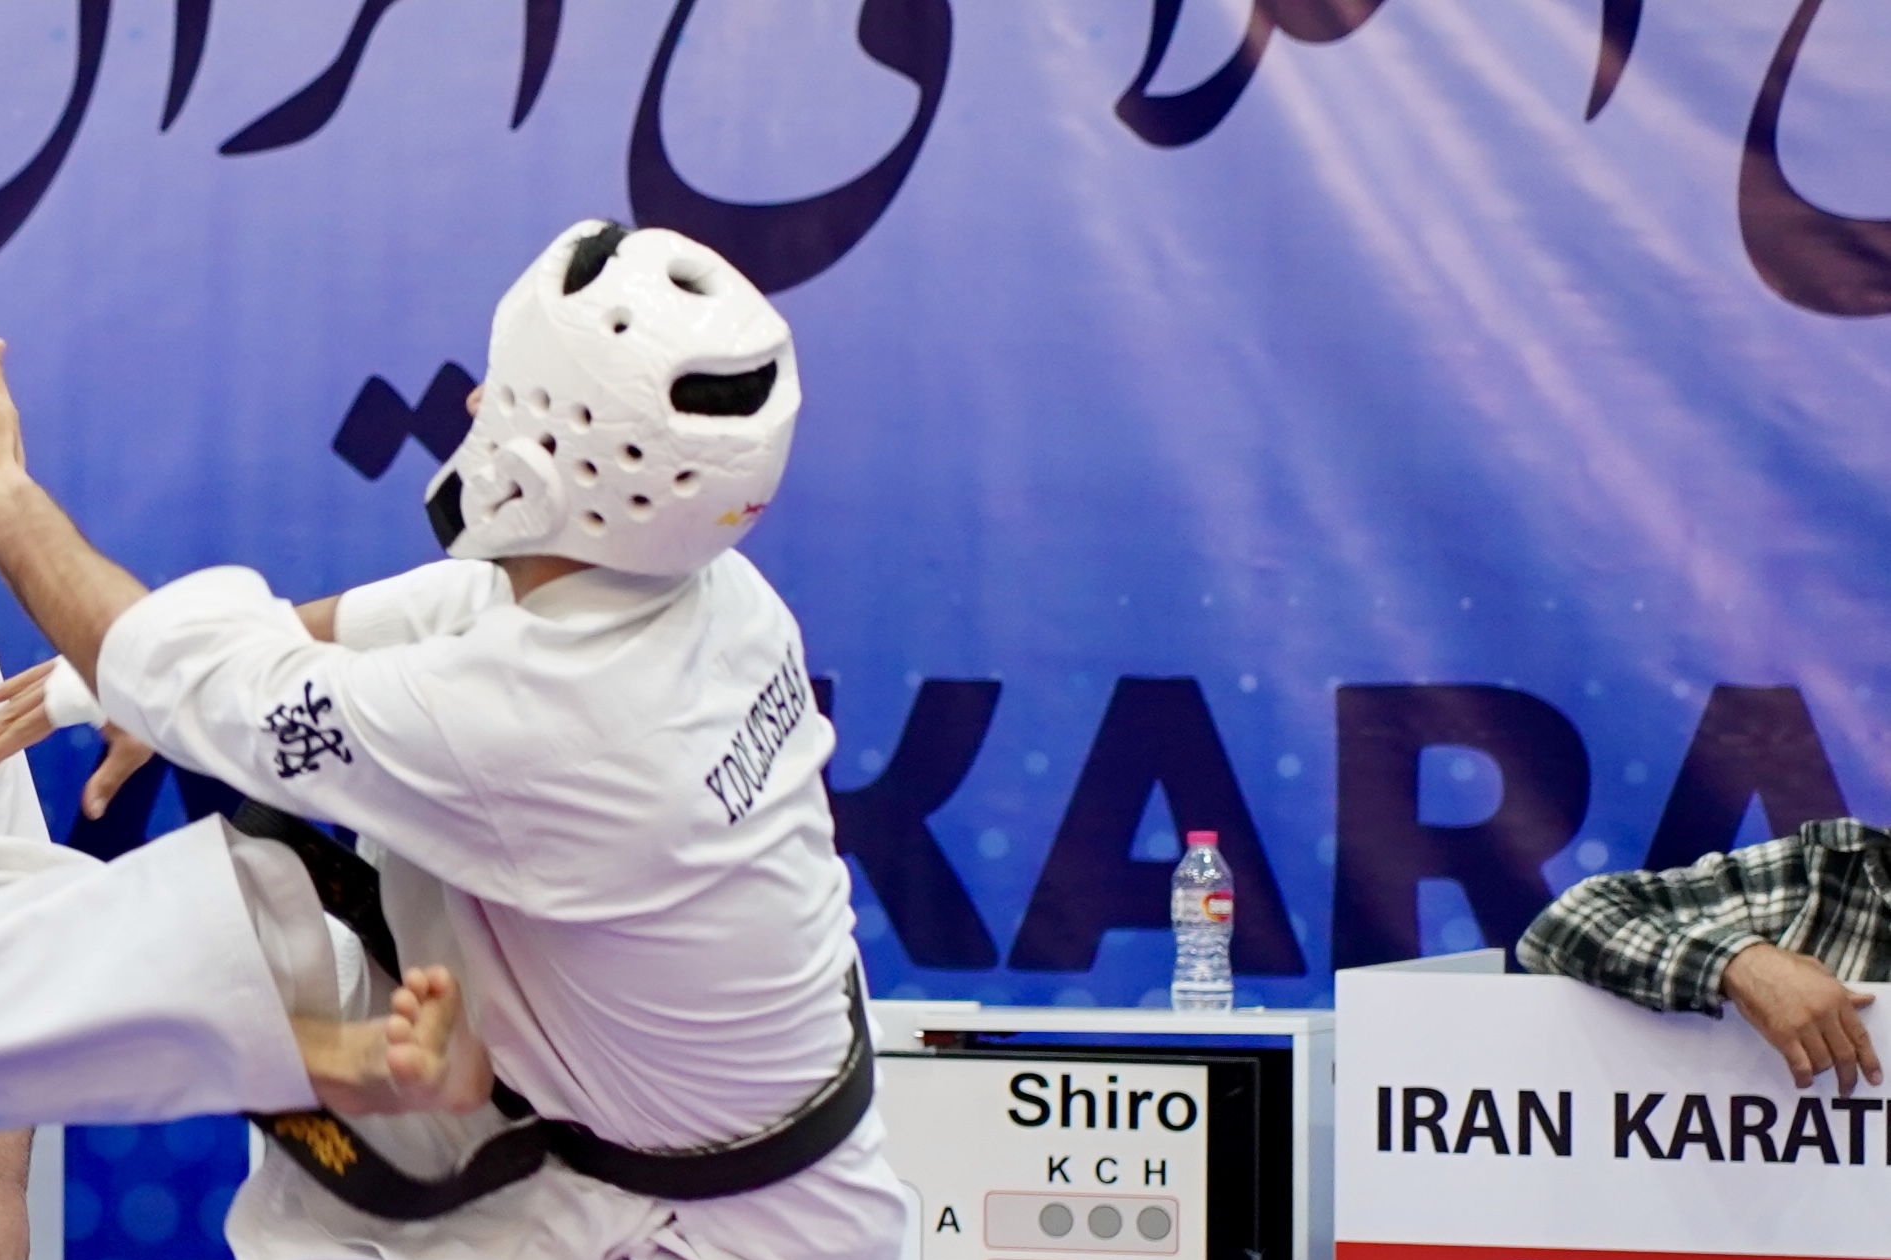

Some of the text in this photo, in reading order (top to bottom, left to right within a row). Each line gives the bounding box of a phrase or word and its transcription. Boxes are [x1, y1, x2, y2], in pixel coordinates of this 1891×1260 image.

[1008, 1072, 1198, 1132] Shiro
[1376, 1086, 1891, 1167] IRAN KARAT
[1048, 1156, 1167, 1186] K C H
[936, 1206, 961, 1234] A
